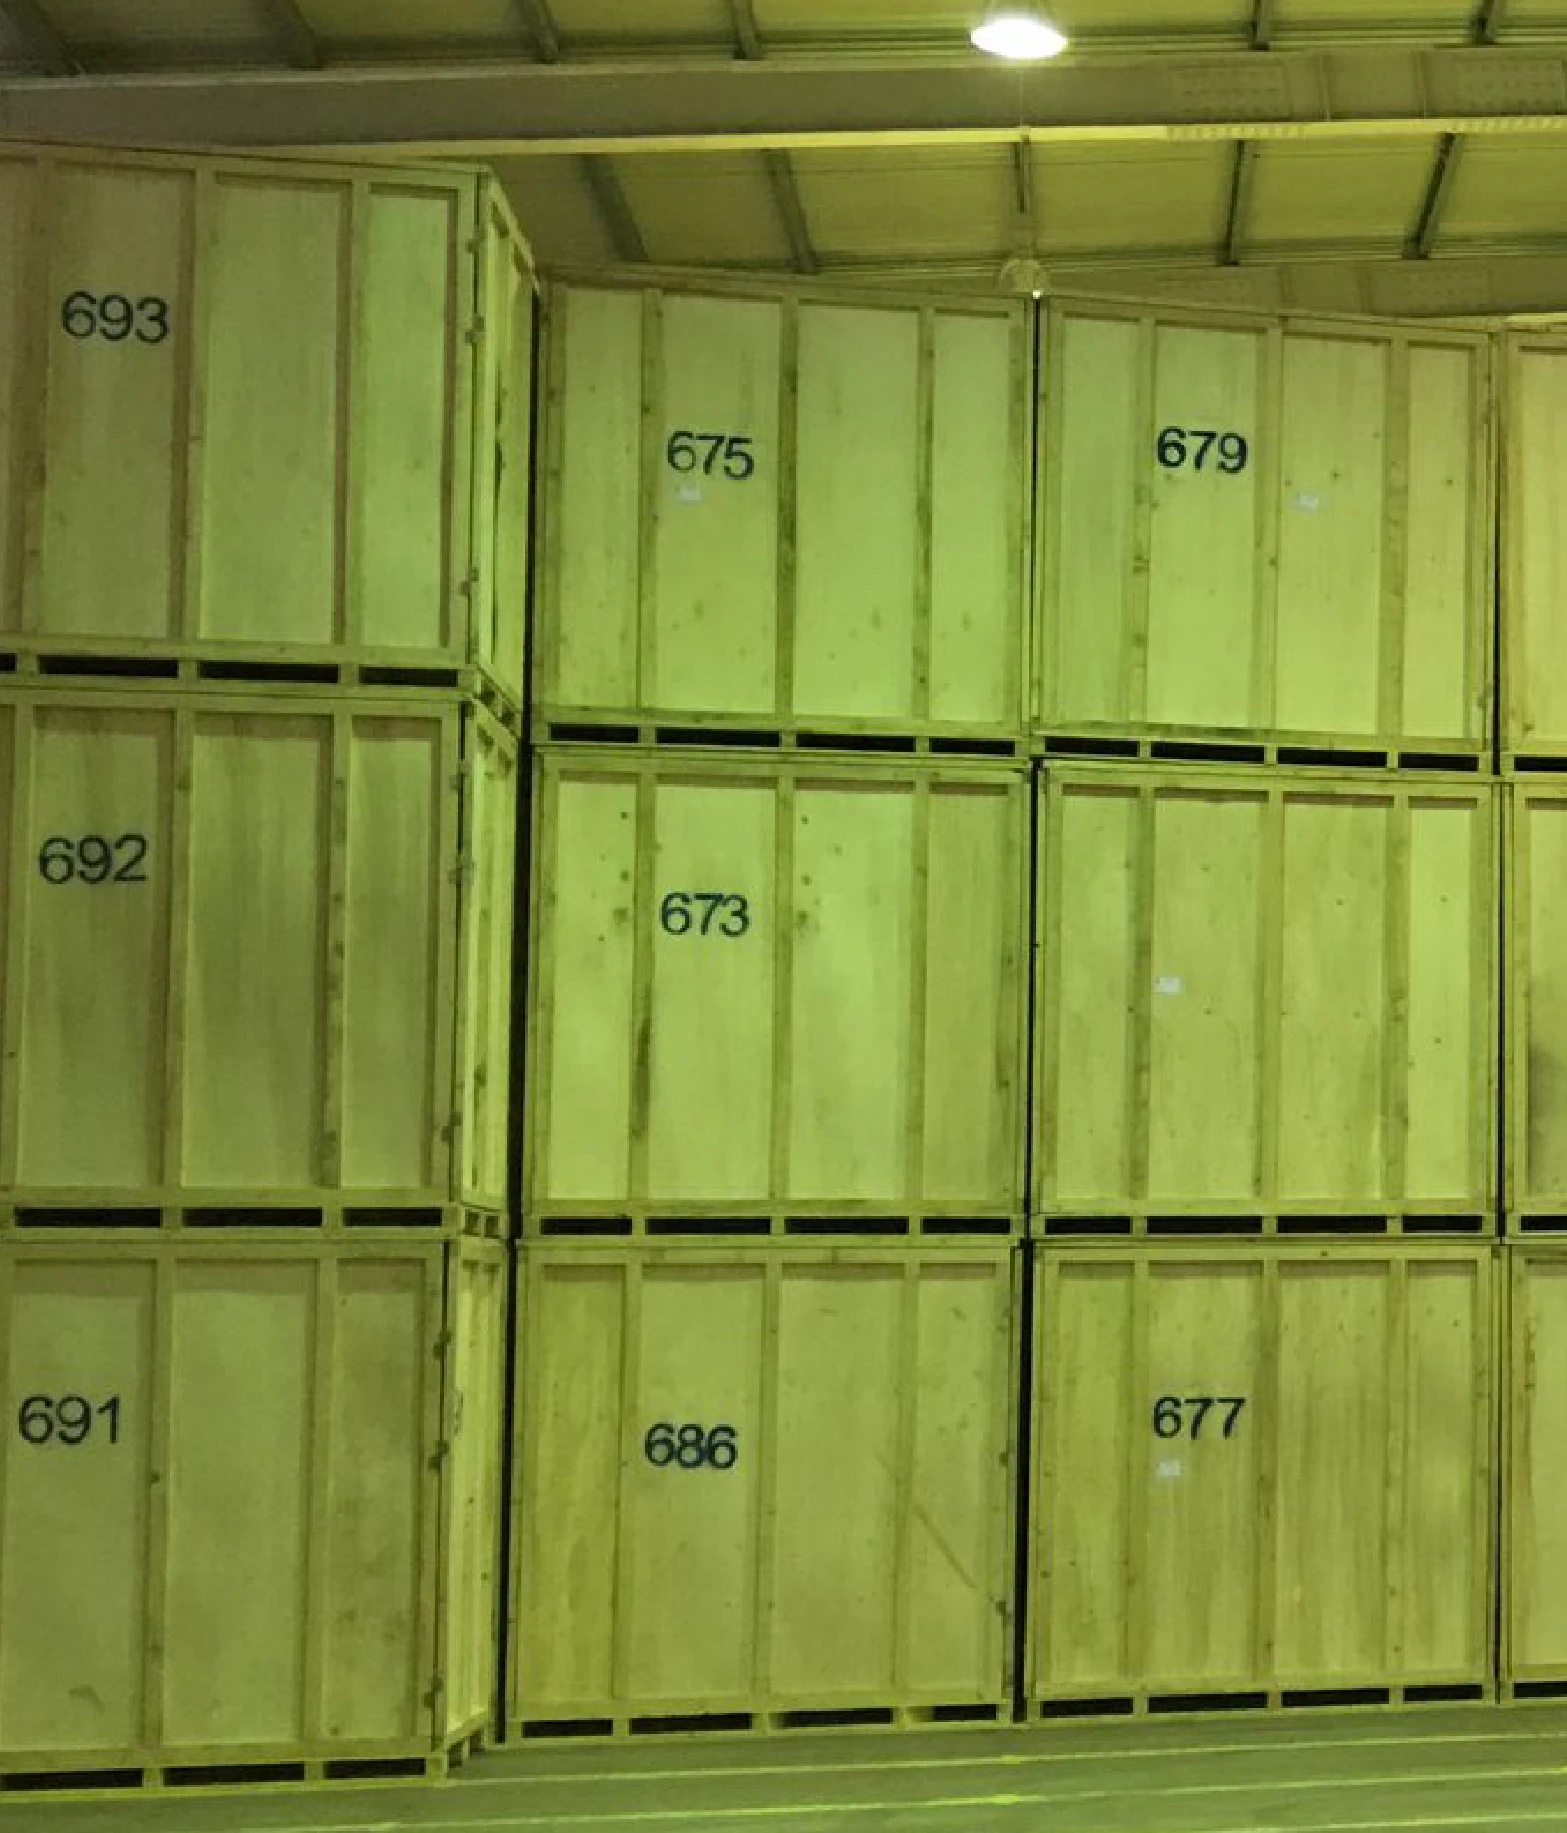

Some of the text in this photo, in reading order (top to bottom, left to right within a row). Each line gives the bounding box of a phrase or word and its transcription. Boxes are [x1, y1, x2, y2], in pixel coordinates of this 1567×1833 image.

[61, 290, 170, 345] 693
[667, 430, 755, 481] 675
[1156, 427, 1248, 474] 679
[38, 834, 149, 885] 692
[660, 891, 751, 939] 673
[18, 1396, 122, 1446] 691
[1152, 1396, 1246, 1441] 677
[644, 1423, 737, 1470] 686
